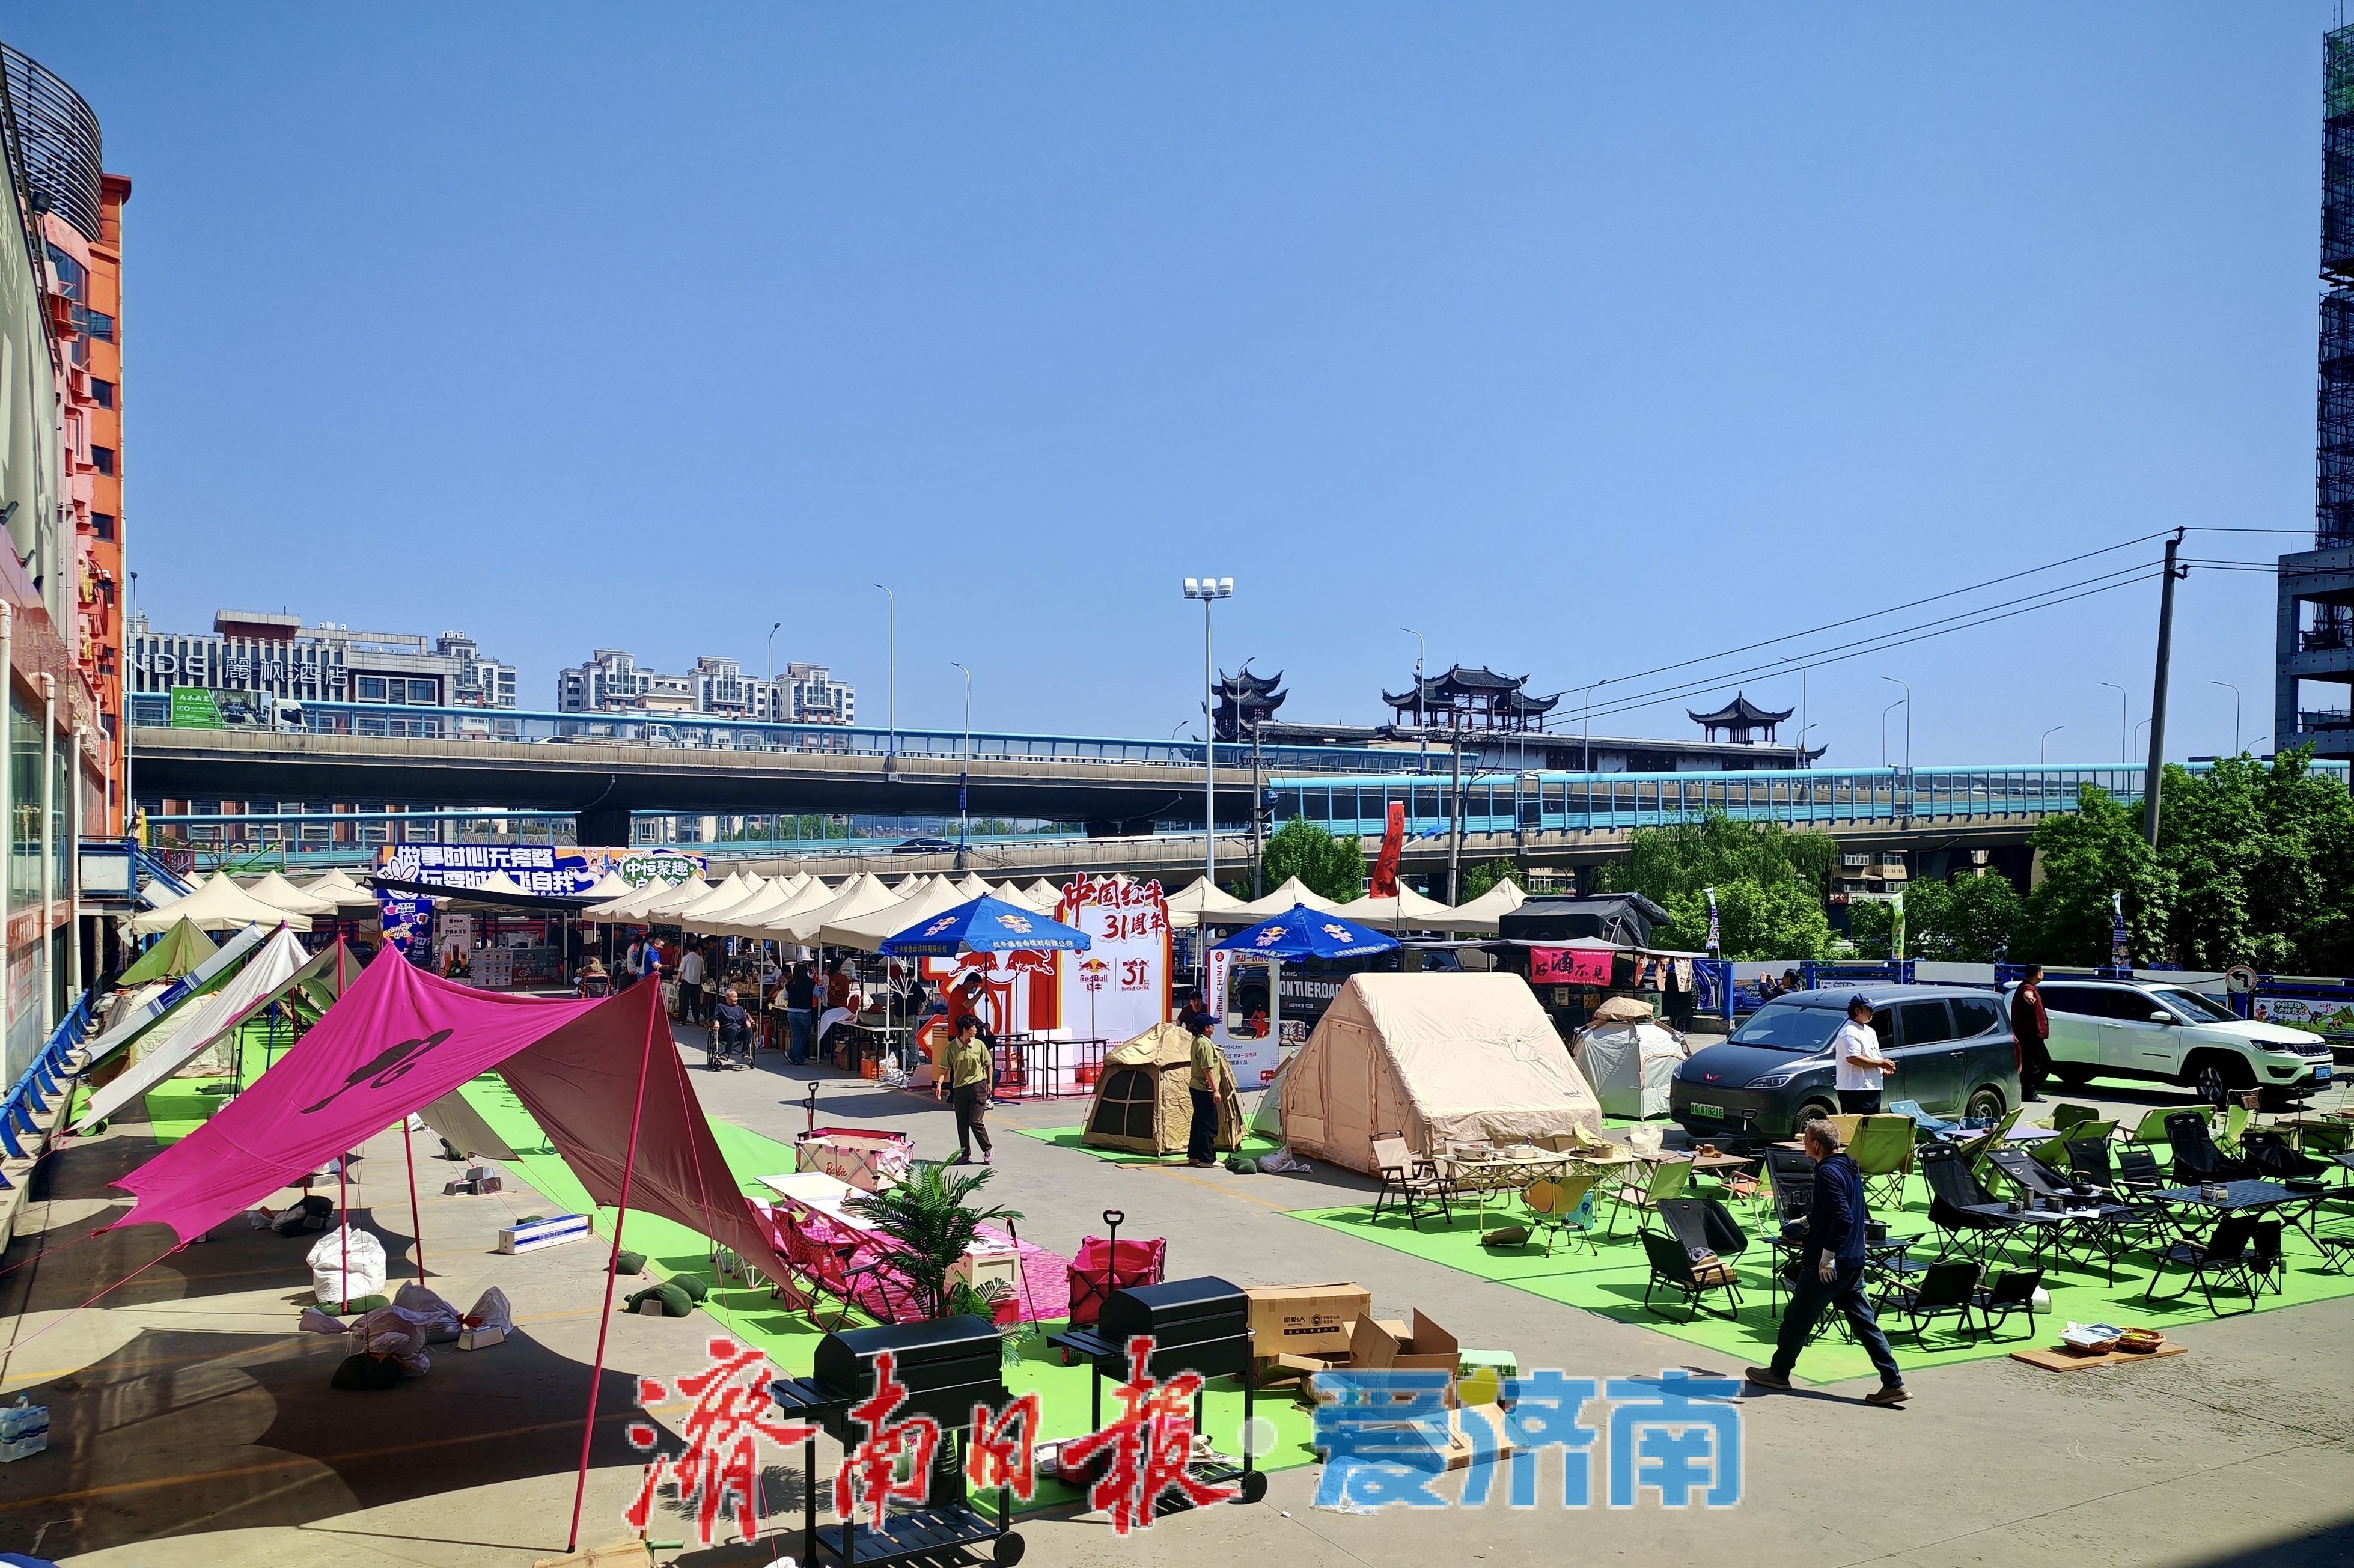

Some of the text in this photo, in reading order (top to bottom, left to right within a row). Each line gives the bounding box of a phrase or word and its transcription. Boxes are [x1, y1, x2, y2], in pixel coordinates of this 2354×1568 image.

[397, 846, 554, 868] 做事时心无旁骛
[420, 870, 574, 891] 玩耍时飞自我
[1063, 873, 1163, 928] 中国红牛
[1100, 912, 1165, 940] 31周年
[1535, 951, 1605, 981] 好酒不见
